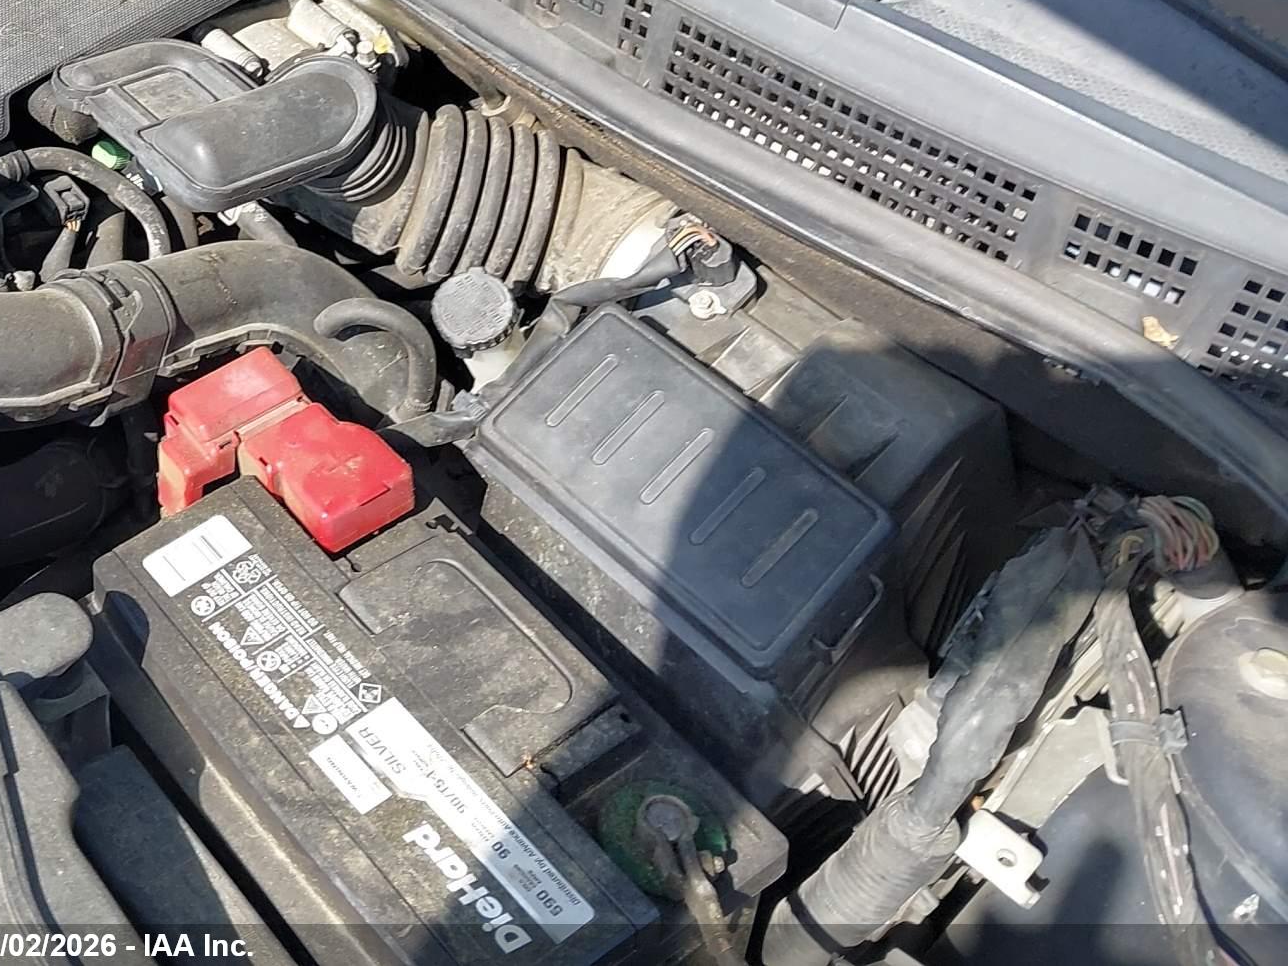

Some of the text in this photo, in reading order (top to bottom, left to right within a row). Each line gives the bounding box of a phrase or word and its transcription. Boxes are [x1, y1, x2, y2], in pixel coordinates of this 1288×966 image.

[209, 620, 300, 721] DANGER/POISON
[356, 725, 407, 775] SILVER
[489, 840, 512, 860] 90
[401, 821, 532, 953] DieHard
[533, 888, 564, 917] 590
[542, 867, 581, 906] Distributed
